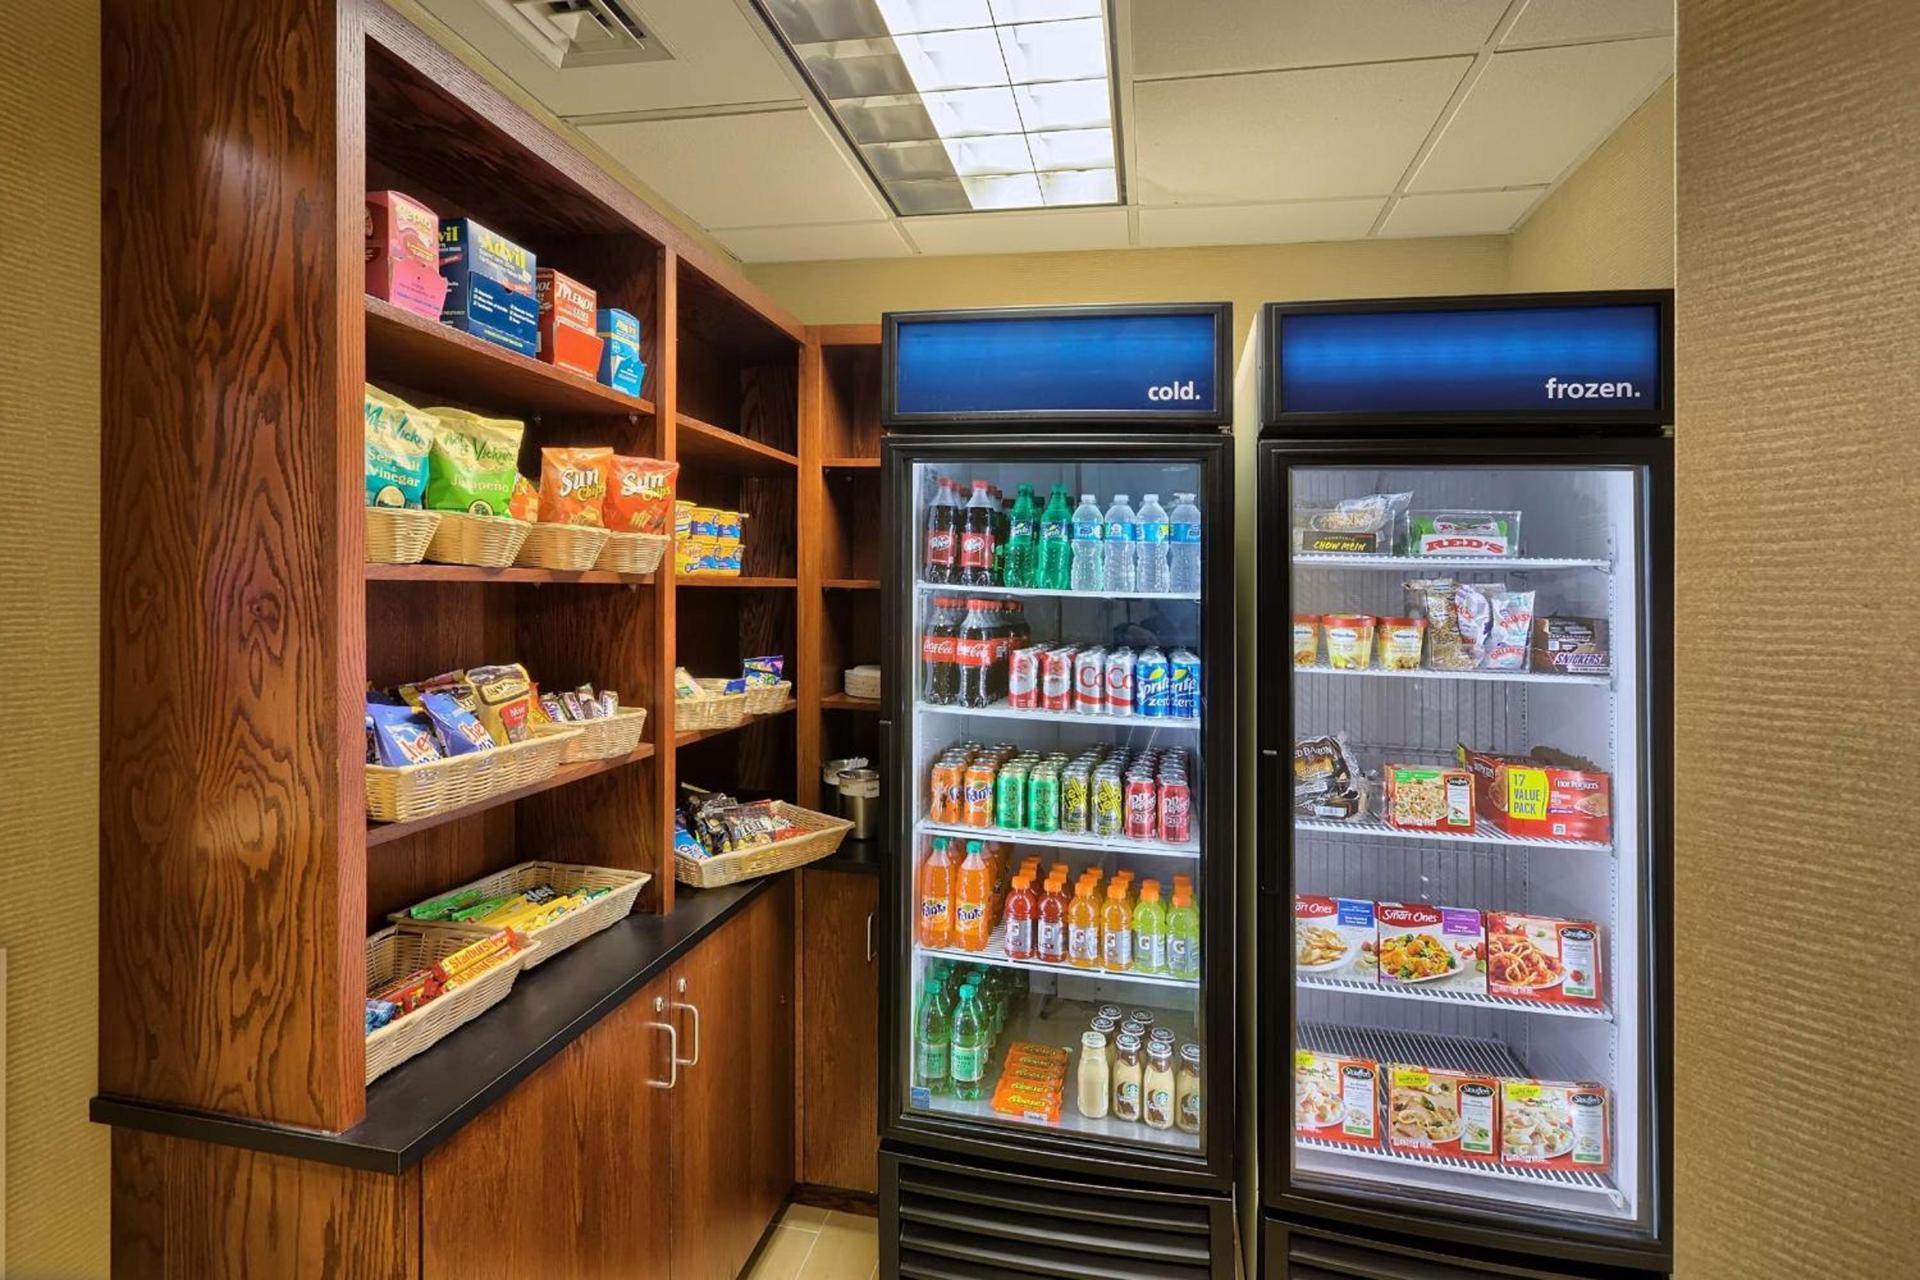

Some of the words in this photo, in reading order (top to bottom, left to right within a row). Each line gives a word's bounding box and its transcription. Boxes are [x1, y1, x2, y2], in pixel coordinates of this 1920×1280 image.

[477, 233, 527, 269] Advil
[1148, 380, 1201, 401] cold.
[1545, 377, 1641, 399] frozen.
[559, 468, 599, 498] Sun
[620, 470, 665, 498] Sun
[1312, 540, 1340, 551] CHOW
[1425, 538, 1505, 554] RED'S
[1555, 652, 1602, 666] SNICKERS
[1513, 774, 1526, 787] 17
[1513, 788, 1541, 801] VALUE
[1513, 801, 1537, 815] PACK
[1309, 903, 1333, 914] Ones
[1383, 909, 1413, 921] Smart
[1413, 911, 1439, 923] Ones
